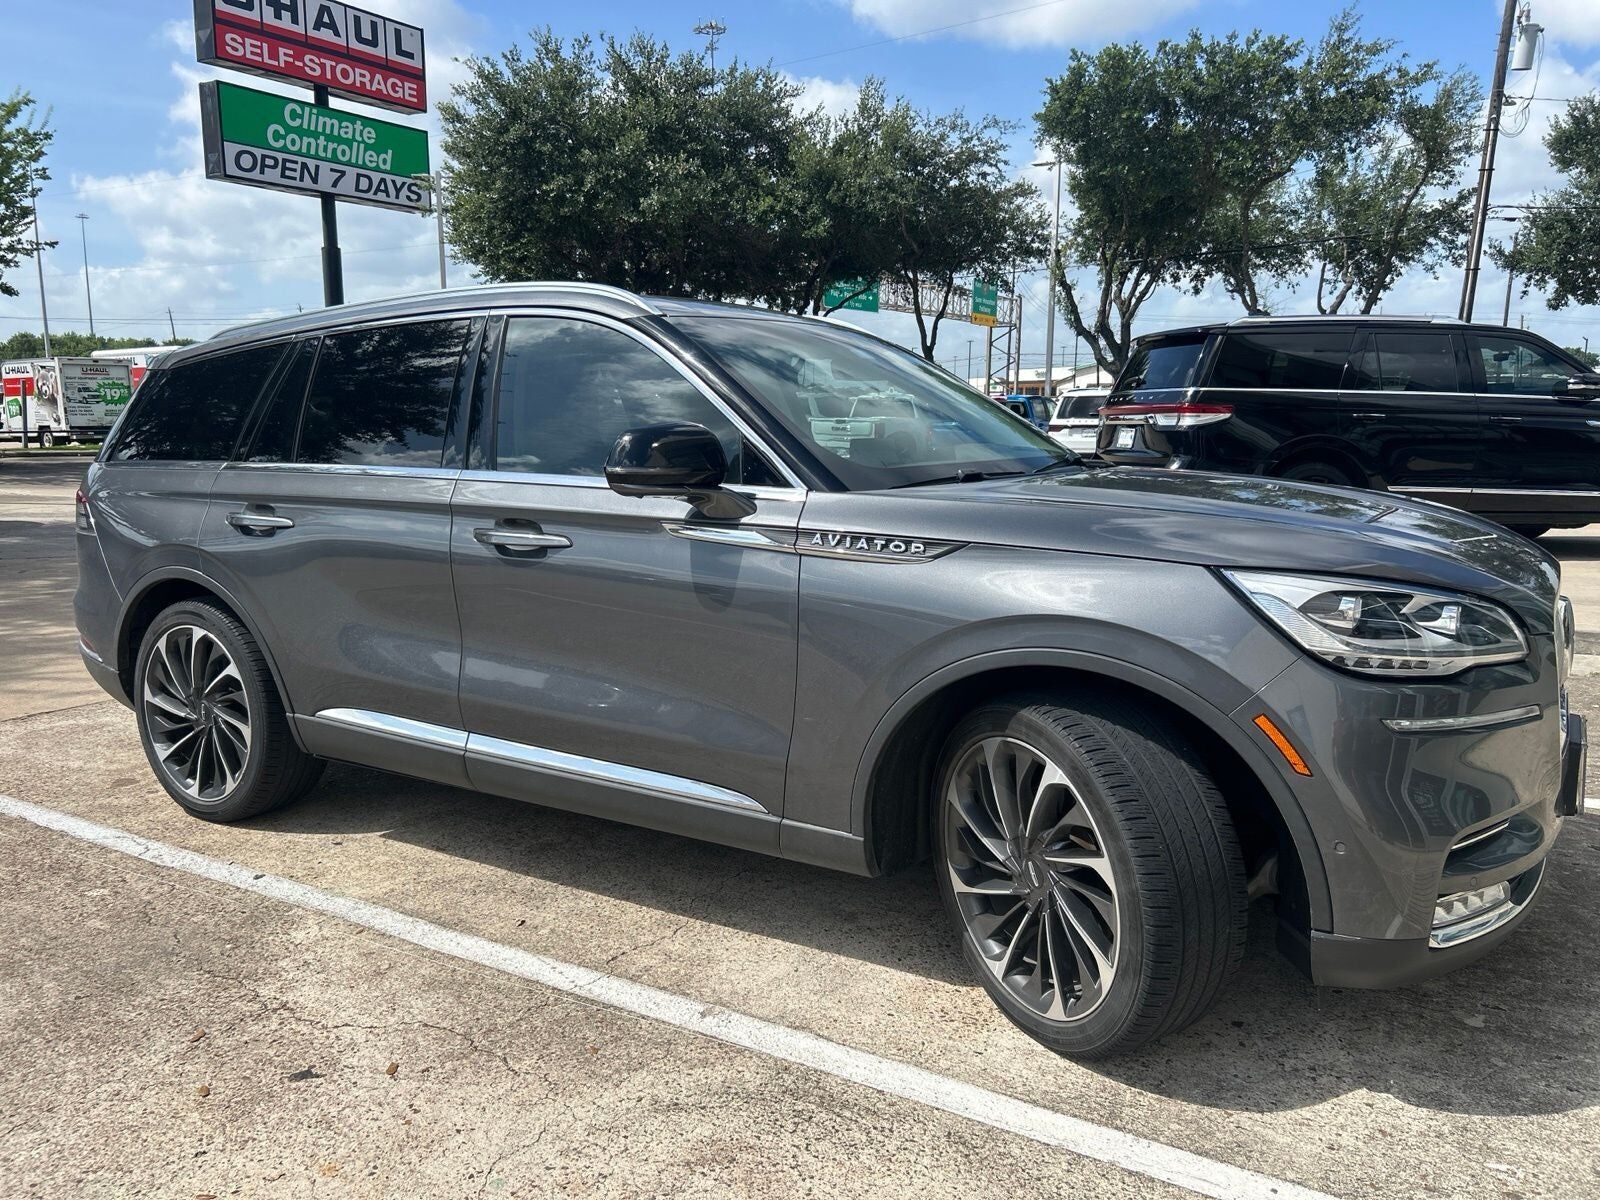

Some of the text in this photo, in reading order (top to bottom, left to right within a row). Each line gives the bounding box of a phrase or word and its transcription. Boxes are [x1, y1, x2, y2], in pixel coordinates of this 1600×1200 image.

[221, 0, 415, 60] -HAUL
[224, 33, 418, 103] SELF-STORAGE
[284, 103, 376, 144] Climate
[266, 124, 393, 171] Controlled
[234, 150, 423, 203] OPEN 7 DAYS
[4, 365, 30, 374] U-HAUL
[811, 532, 925, 554] AVIATOR
